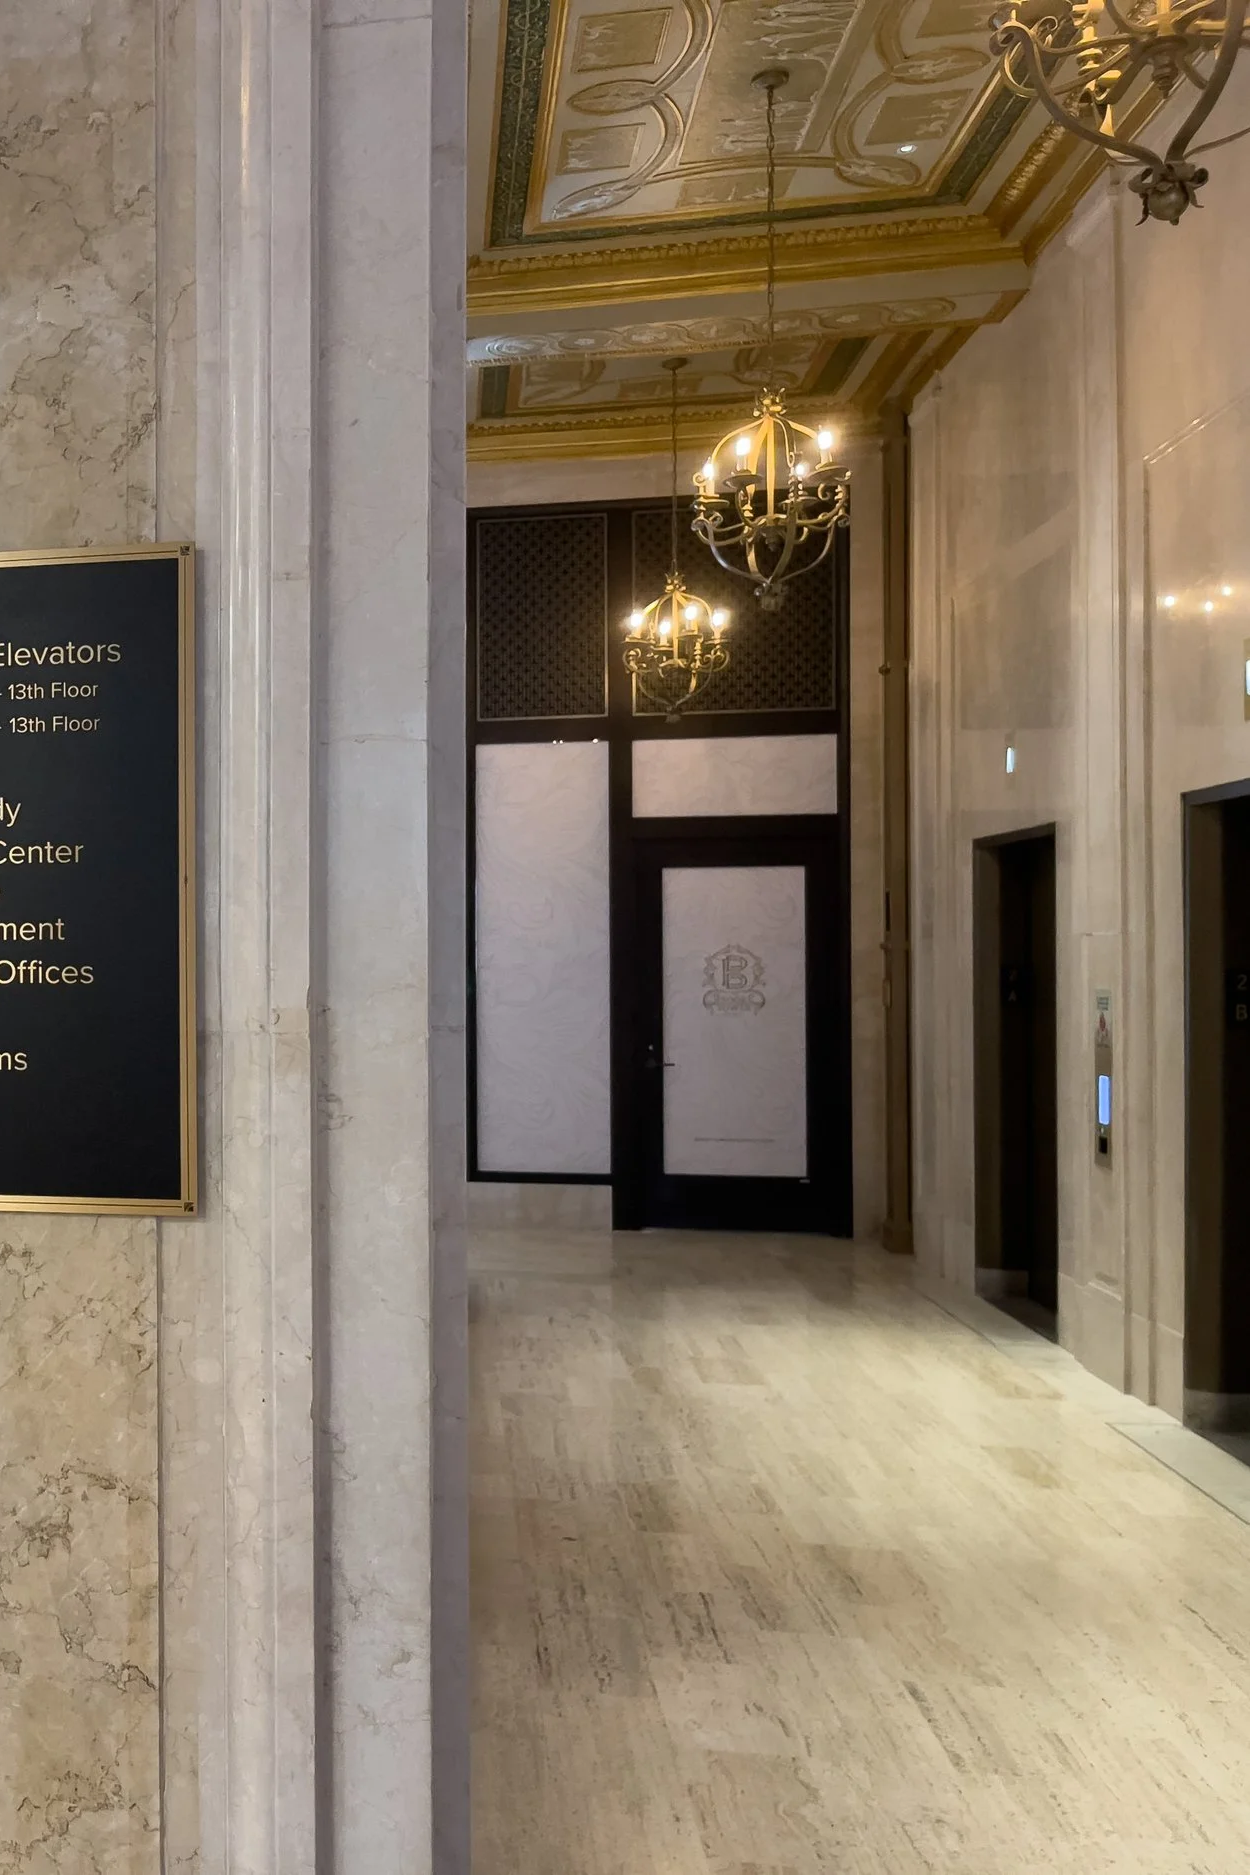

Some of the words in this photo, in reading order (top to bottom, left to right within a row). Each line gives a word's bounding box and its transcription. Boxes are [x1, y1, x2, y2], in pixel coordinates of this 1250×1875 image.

[7, 682, 45, 701] 13th
[51, 681, 99, 699] Floor
[9, 716, 46, 734] 13th
[52, 715, 101, 733] Floor
[1236, 973, 1248, 991] 2
[1235, 1003, 1249, 1021] B
